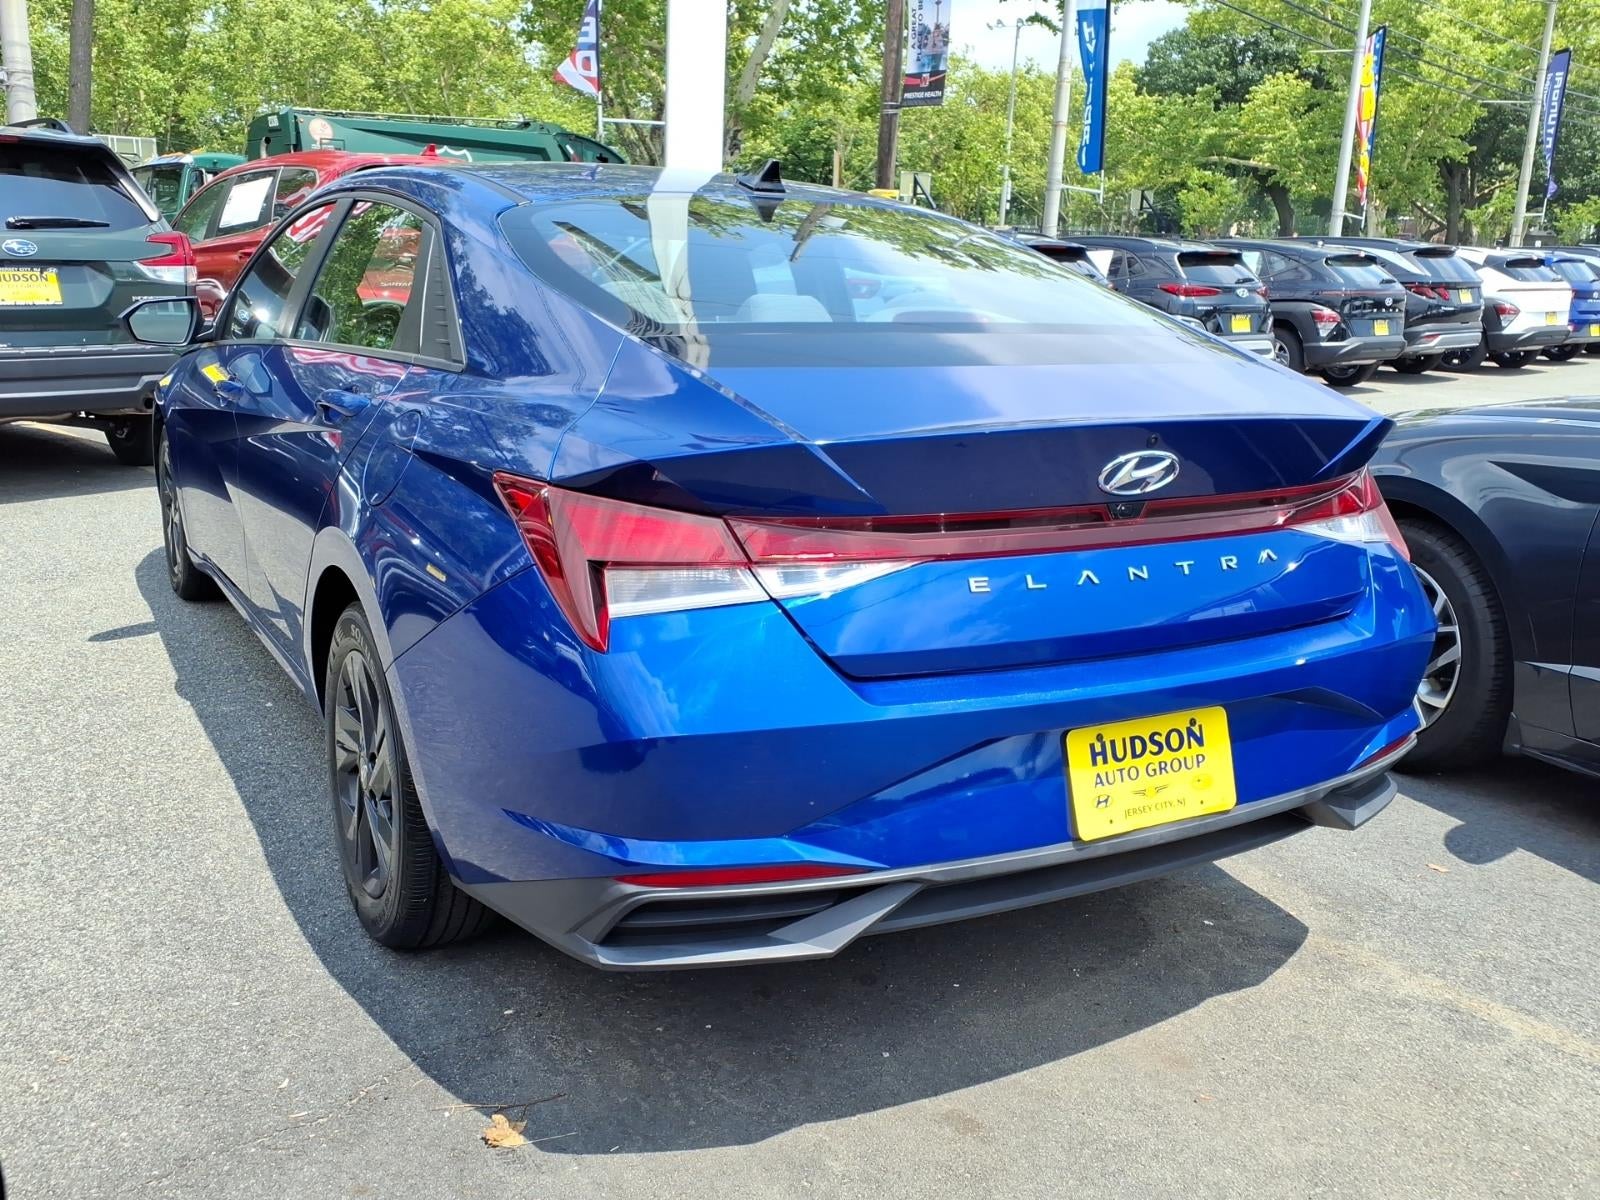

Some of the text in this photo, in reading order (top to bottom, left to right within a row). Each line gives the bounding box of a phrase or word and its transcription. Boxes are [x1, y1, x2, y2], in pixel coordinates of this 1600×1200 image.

[918, 13, 924, 26] TO
[903, 90, 942, 99] PRESTIGE HEALTH
[1081, 21, 1096, 167] HYDAI
[0, 273, 49, 282] UDSON
[967, 548, 1278, 593] ELANTRA
[1089, 724, 1205, 767] HUDSON
[1094, 754, 1206, 788] AUTO GROUP
[1124, 803, 1153, 819] JERSEY
[1176, 799, 1187, 808] NJ
